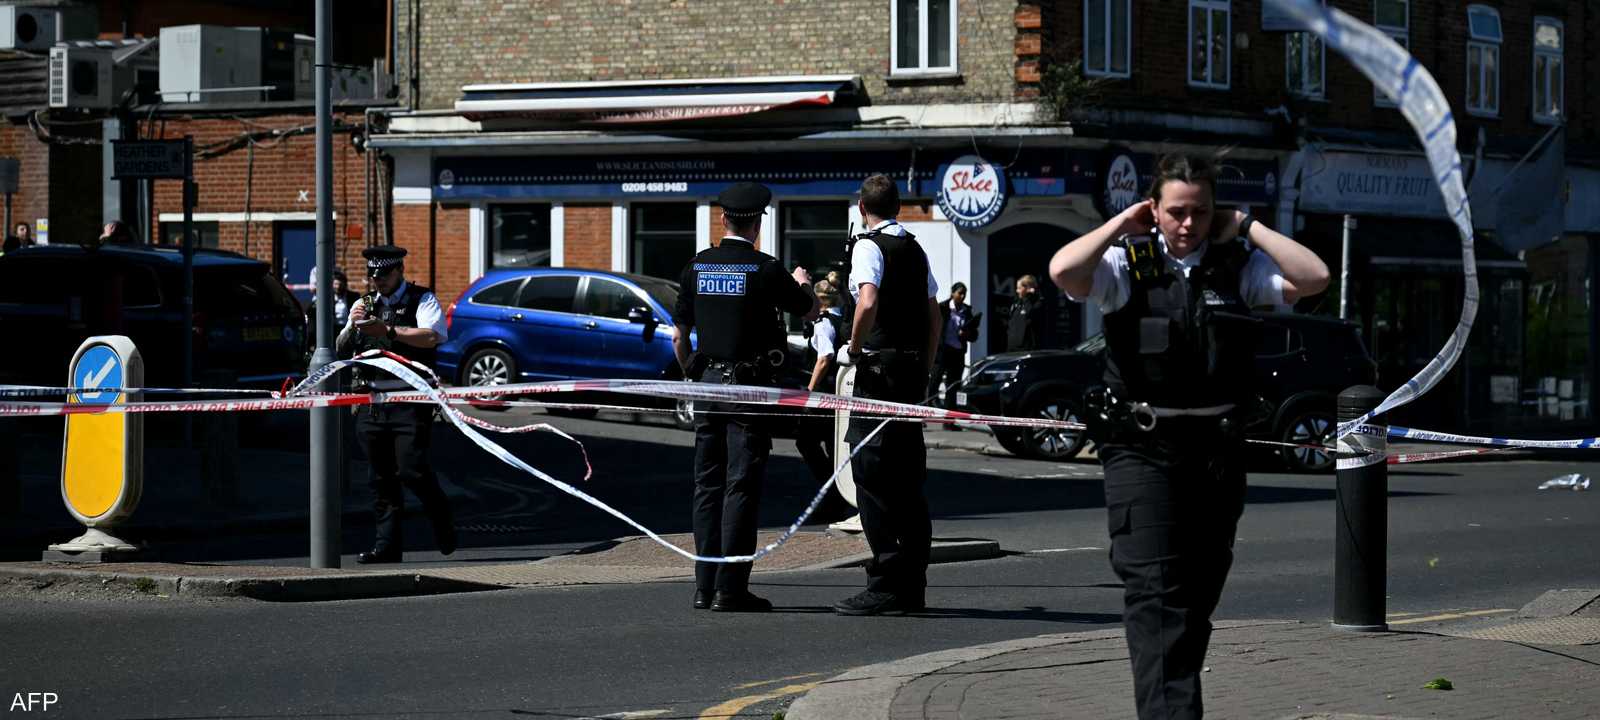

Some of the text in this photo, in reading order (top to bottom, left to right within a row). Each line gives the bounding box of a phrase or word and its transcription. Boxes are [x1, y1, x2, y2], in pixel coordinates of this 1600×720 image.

[654, 107, 684, 120] SUSHI
[114, 145, 166, 158] HEATHER
[114, 161, 169, 173] GARDENS
[596, 160, 716, 171] WWW.SLICEANDSUSHI.COM
[622, 182, 646, 192] 0208
[647, 182, 664, 192] 458
[950, 171, 993, 192] Slice
[1111, 171, 1135, 192] Slice
[1337, 172, 1431, 196] QUALITY FRUIT
[698, 280, 744, 293] POLICE
